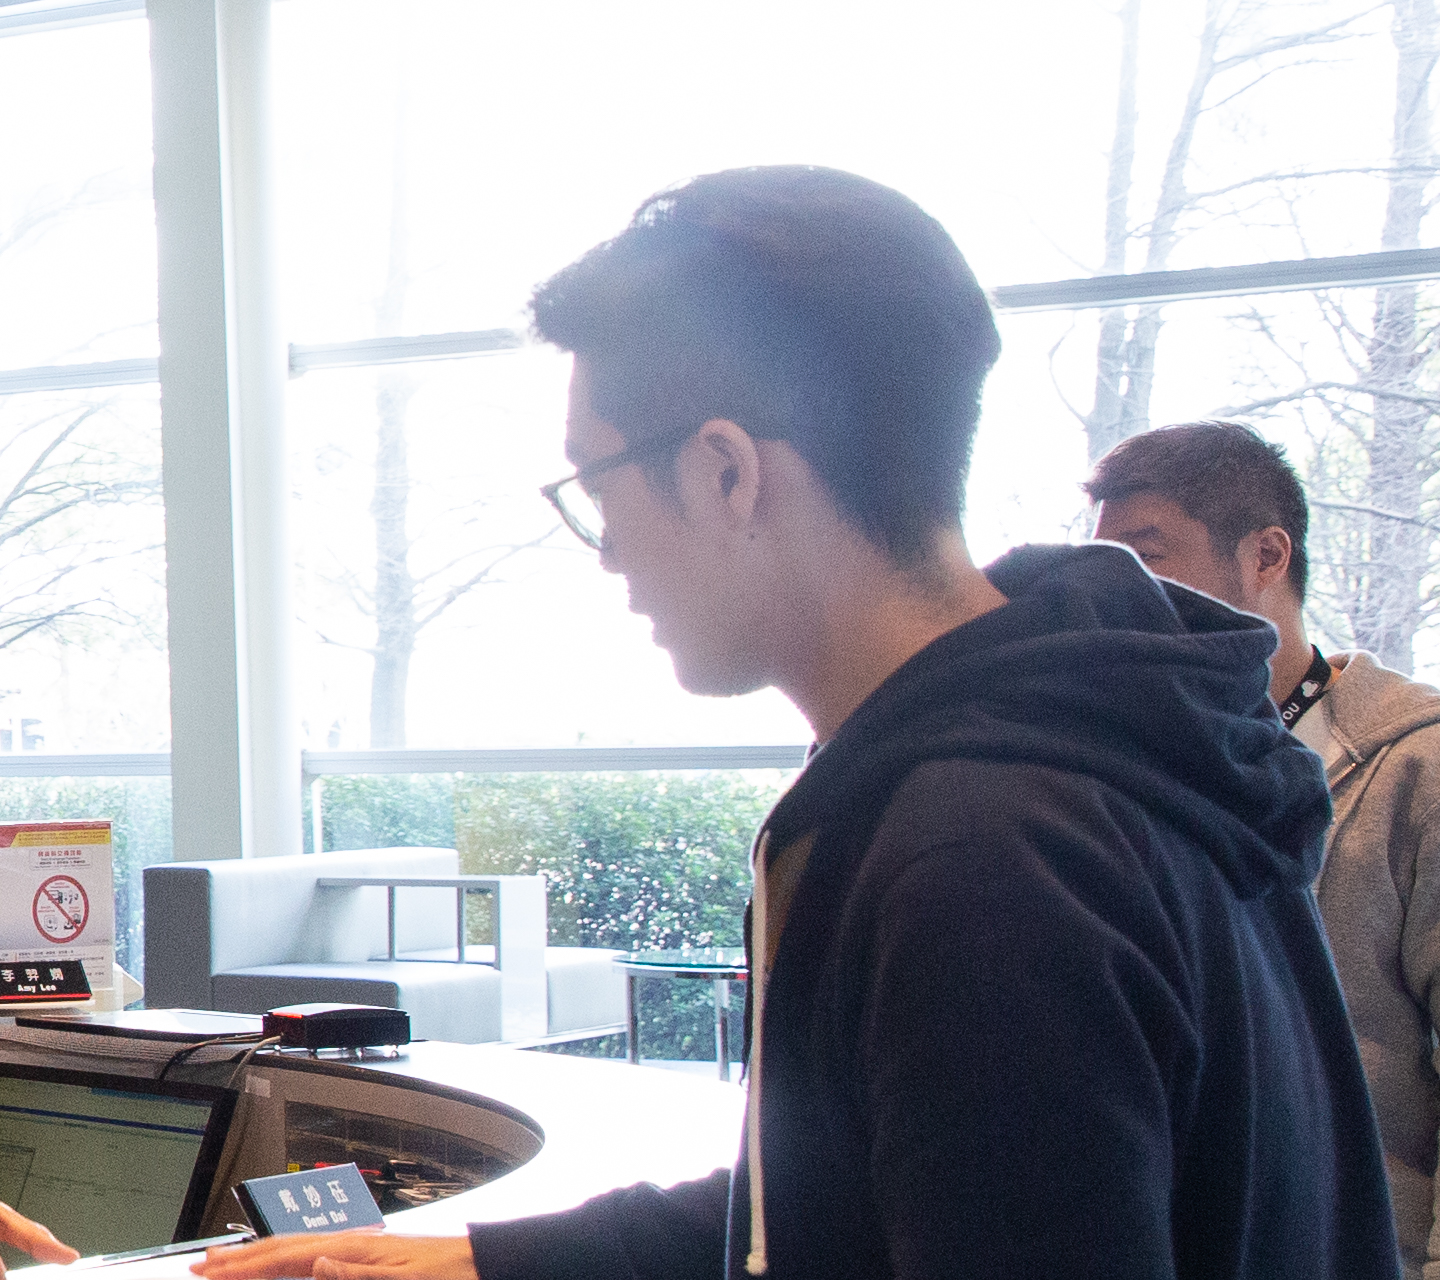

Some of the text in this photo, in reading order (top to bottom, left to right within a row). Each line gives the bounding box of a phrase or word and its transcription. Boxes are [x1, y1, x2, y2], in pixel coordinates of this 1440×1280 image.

[17, 984, 36, 993] Amy
[301, 1209, 348, 1228] Demi Dai
